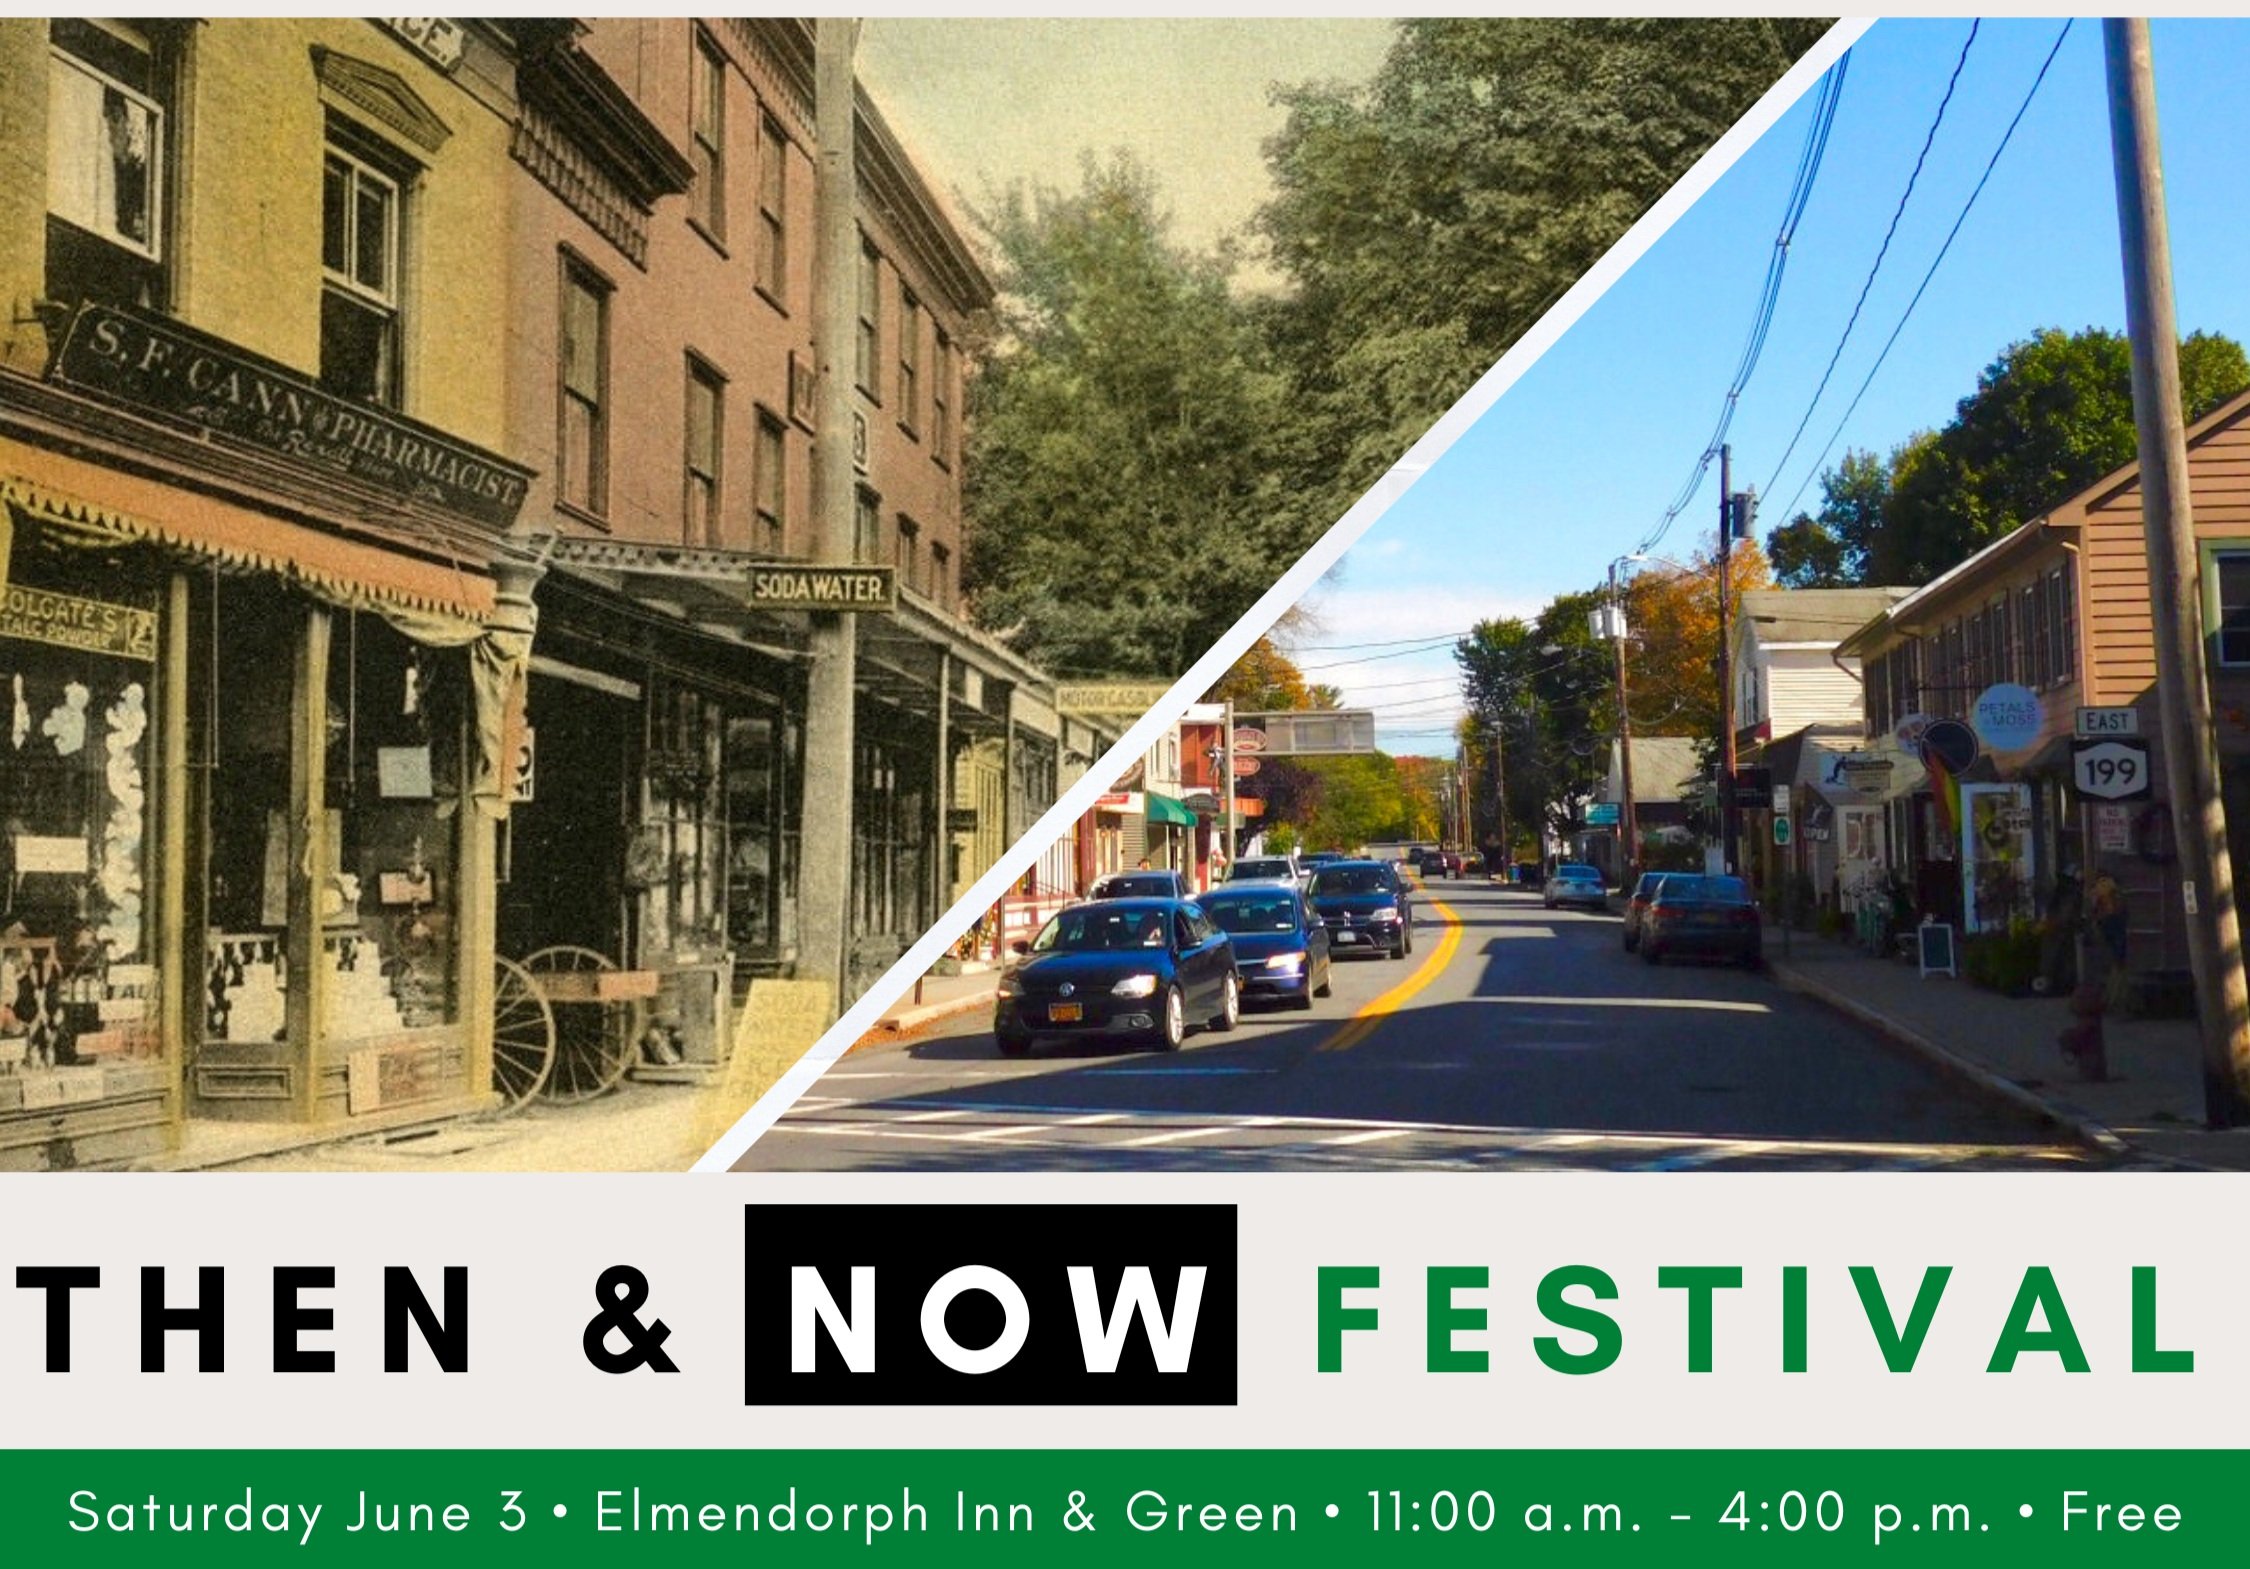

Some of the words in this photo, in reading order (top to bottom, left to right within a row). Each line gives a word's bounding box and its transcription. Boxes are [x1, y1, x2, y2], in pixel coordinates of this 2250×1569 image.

[389, 16, 451, 62] CE.
[188, 357, 311, 425] CANN
[755, 573, 810, 600] SODA
[2, 590, 119, 633] OLGATE'S
[1979, 702, 2036, 716] PETALS
[1992, 714, 2036, 727] MOSS
[2086, 711, 2129, 731] EAST
[2084, 758, 2137, 786] 199
